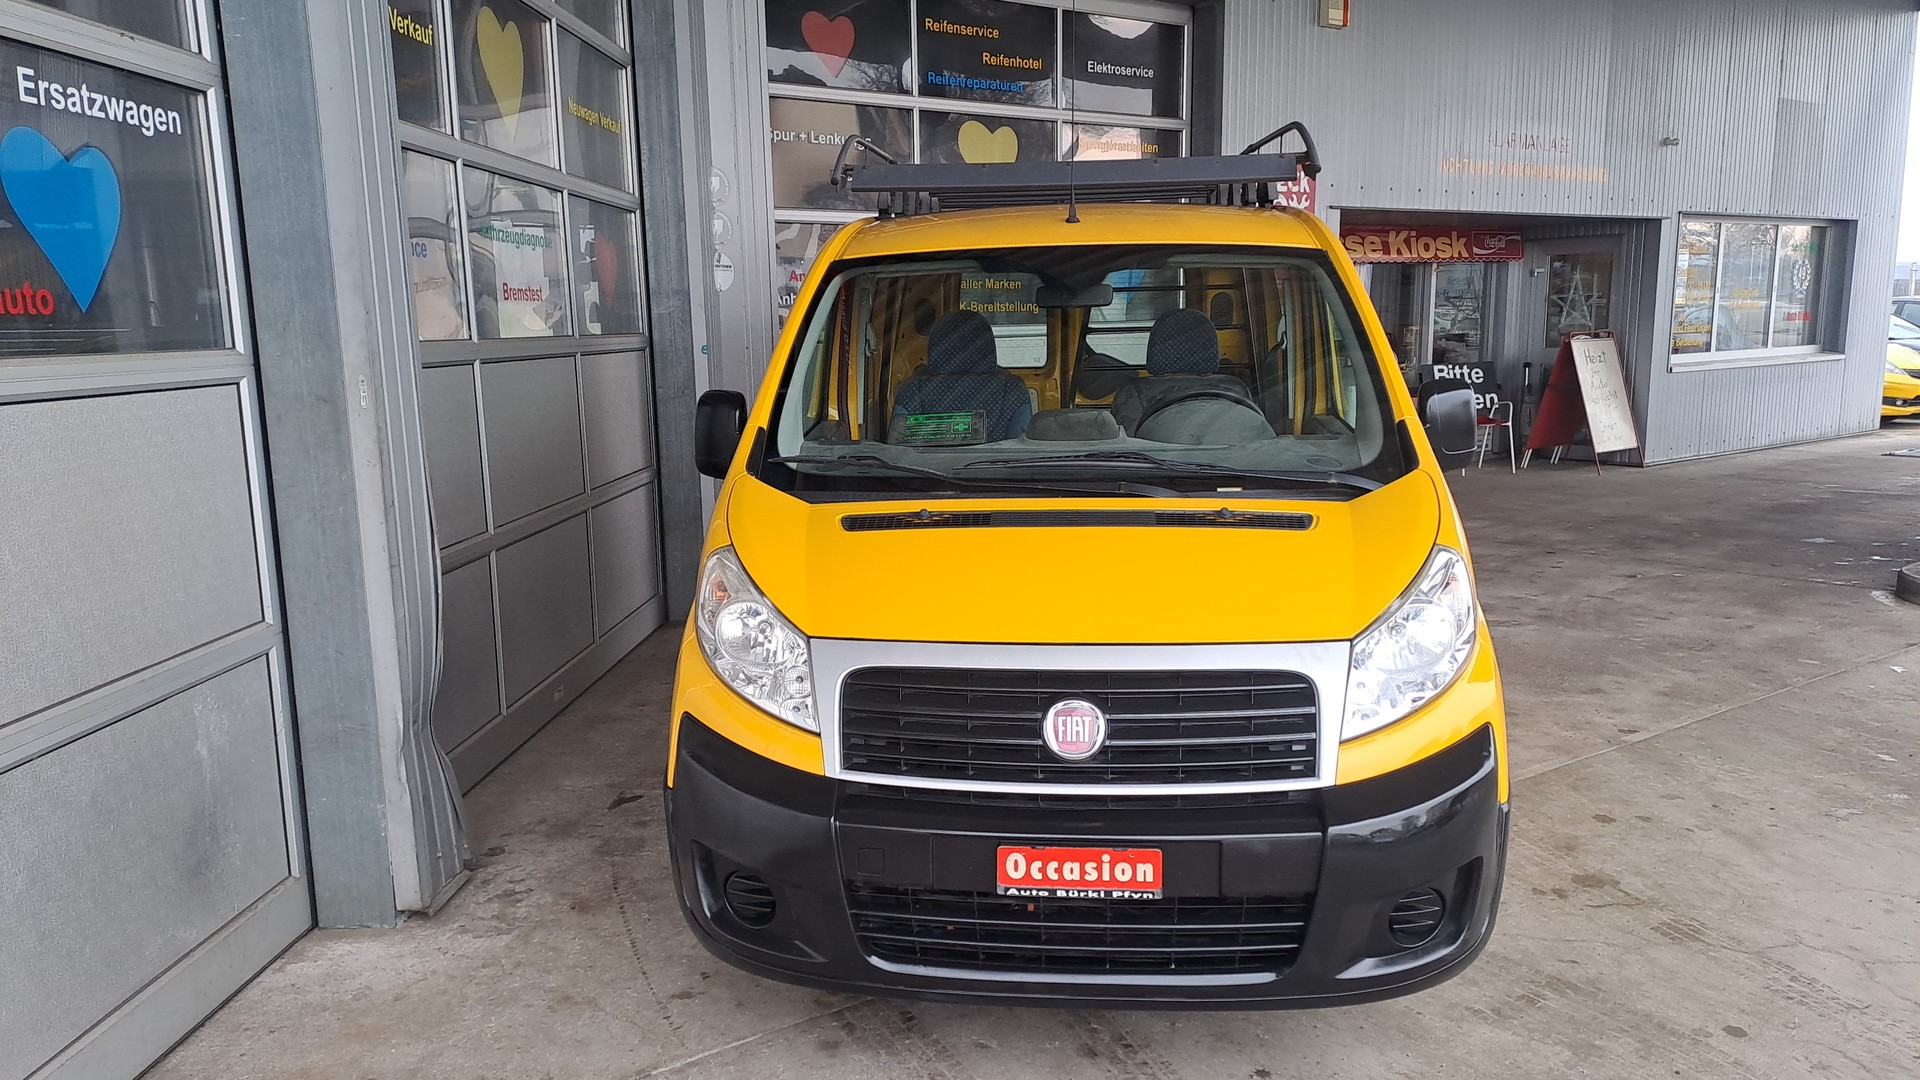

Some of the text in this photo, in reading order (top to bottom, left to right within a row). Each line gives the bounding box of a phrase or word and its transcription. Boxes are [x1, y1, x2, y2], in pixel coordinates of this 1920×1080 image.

[388, 5, 433, 46] Verkauf
[925, 18, 1000, 39] Reifenservice
[982, 52, 1043, 70] Reifenhotel
[1087, 60, 1154, 78] Elektroservice
[927, 71, 1024, 92] Reifenreparaturen
[16, 66, 182, 137] Ersatzwagen
[568, 96, 621, 134] Neuwagen Verkauf
[1387, 231, 1469, 259] Kiosk
[502, 282, 544, 303] Bremstest
[960, 278, 1021, 290] aller Marken
[959, 301, 1040, 314] K-Bereitstellung
[1433, 364, 1484, 384] Bitte
[1057, 716, 1092, 743] FIAT
[1005, 852, 1154, 883] Occasion
[1006, 888, 1155, 899] Auto Bürki Pfyn
